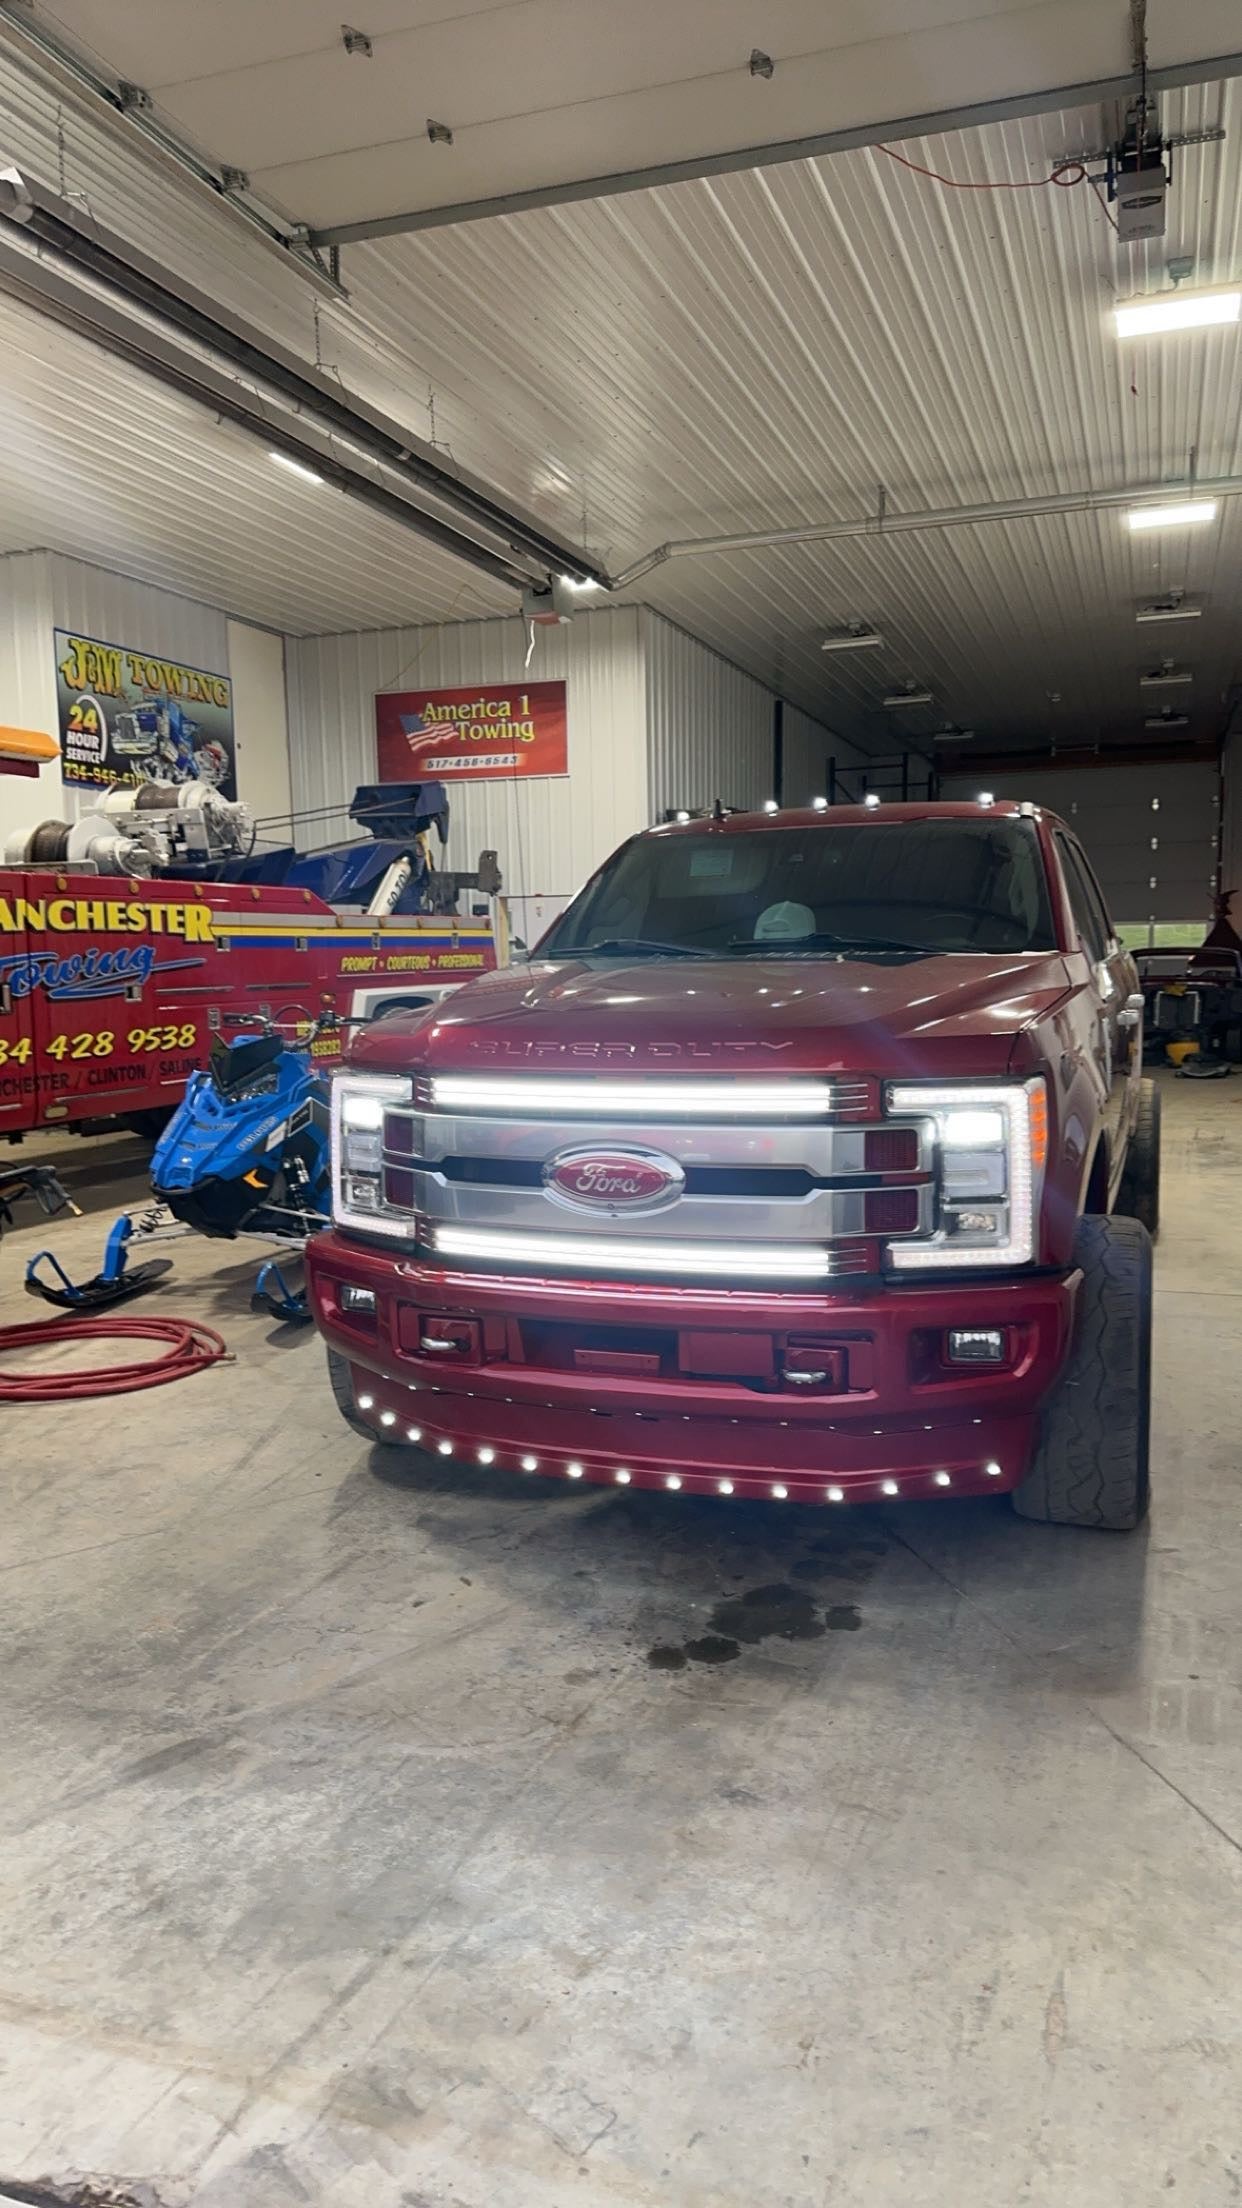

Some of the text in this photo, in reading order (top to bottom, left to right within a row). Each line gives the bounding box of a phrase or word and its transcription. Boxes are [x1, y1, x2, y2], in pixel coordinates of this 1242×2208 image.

[127, 653, 229, 709] TOWING
[67, 704, 98, 733] 24
[418, 695, 531, 723] America 1
[66, 731, 100, 750] HOUR
[454, 718, 535, 742] Towing
[66, 748, 102, 765] SERVICE
[46, 1031, 115, 1060] 428
[127, 1023, 197, 1053] 9538
[469, 1041, 794, 1058] SUPER DUTY
[88, 1064, 146, 1085] CLINTON
[159, 1057, 201, 1076] SALINE
[575, 1163, 641, 1194] Ford
